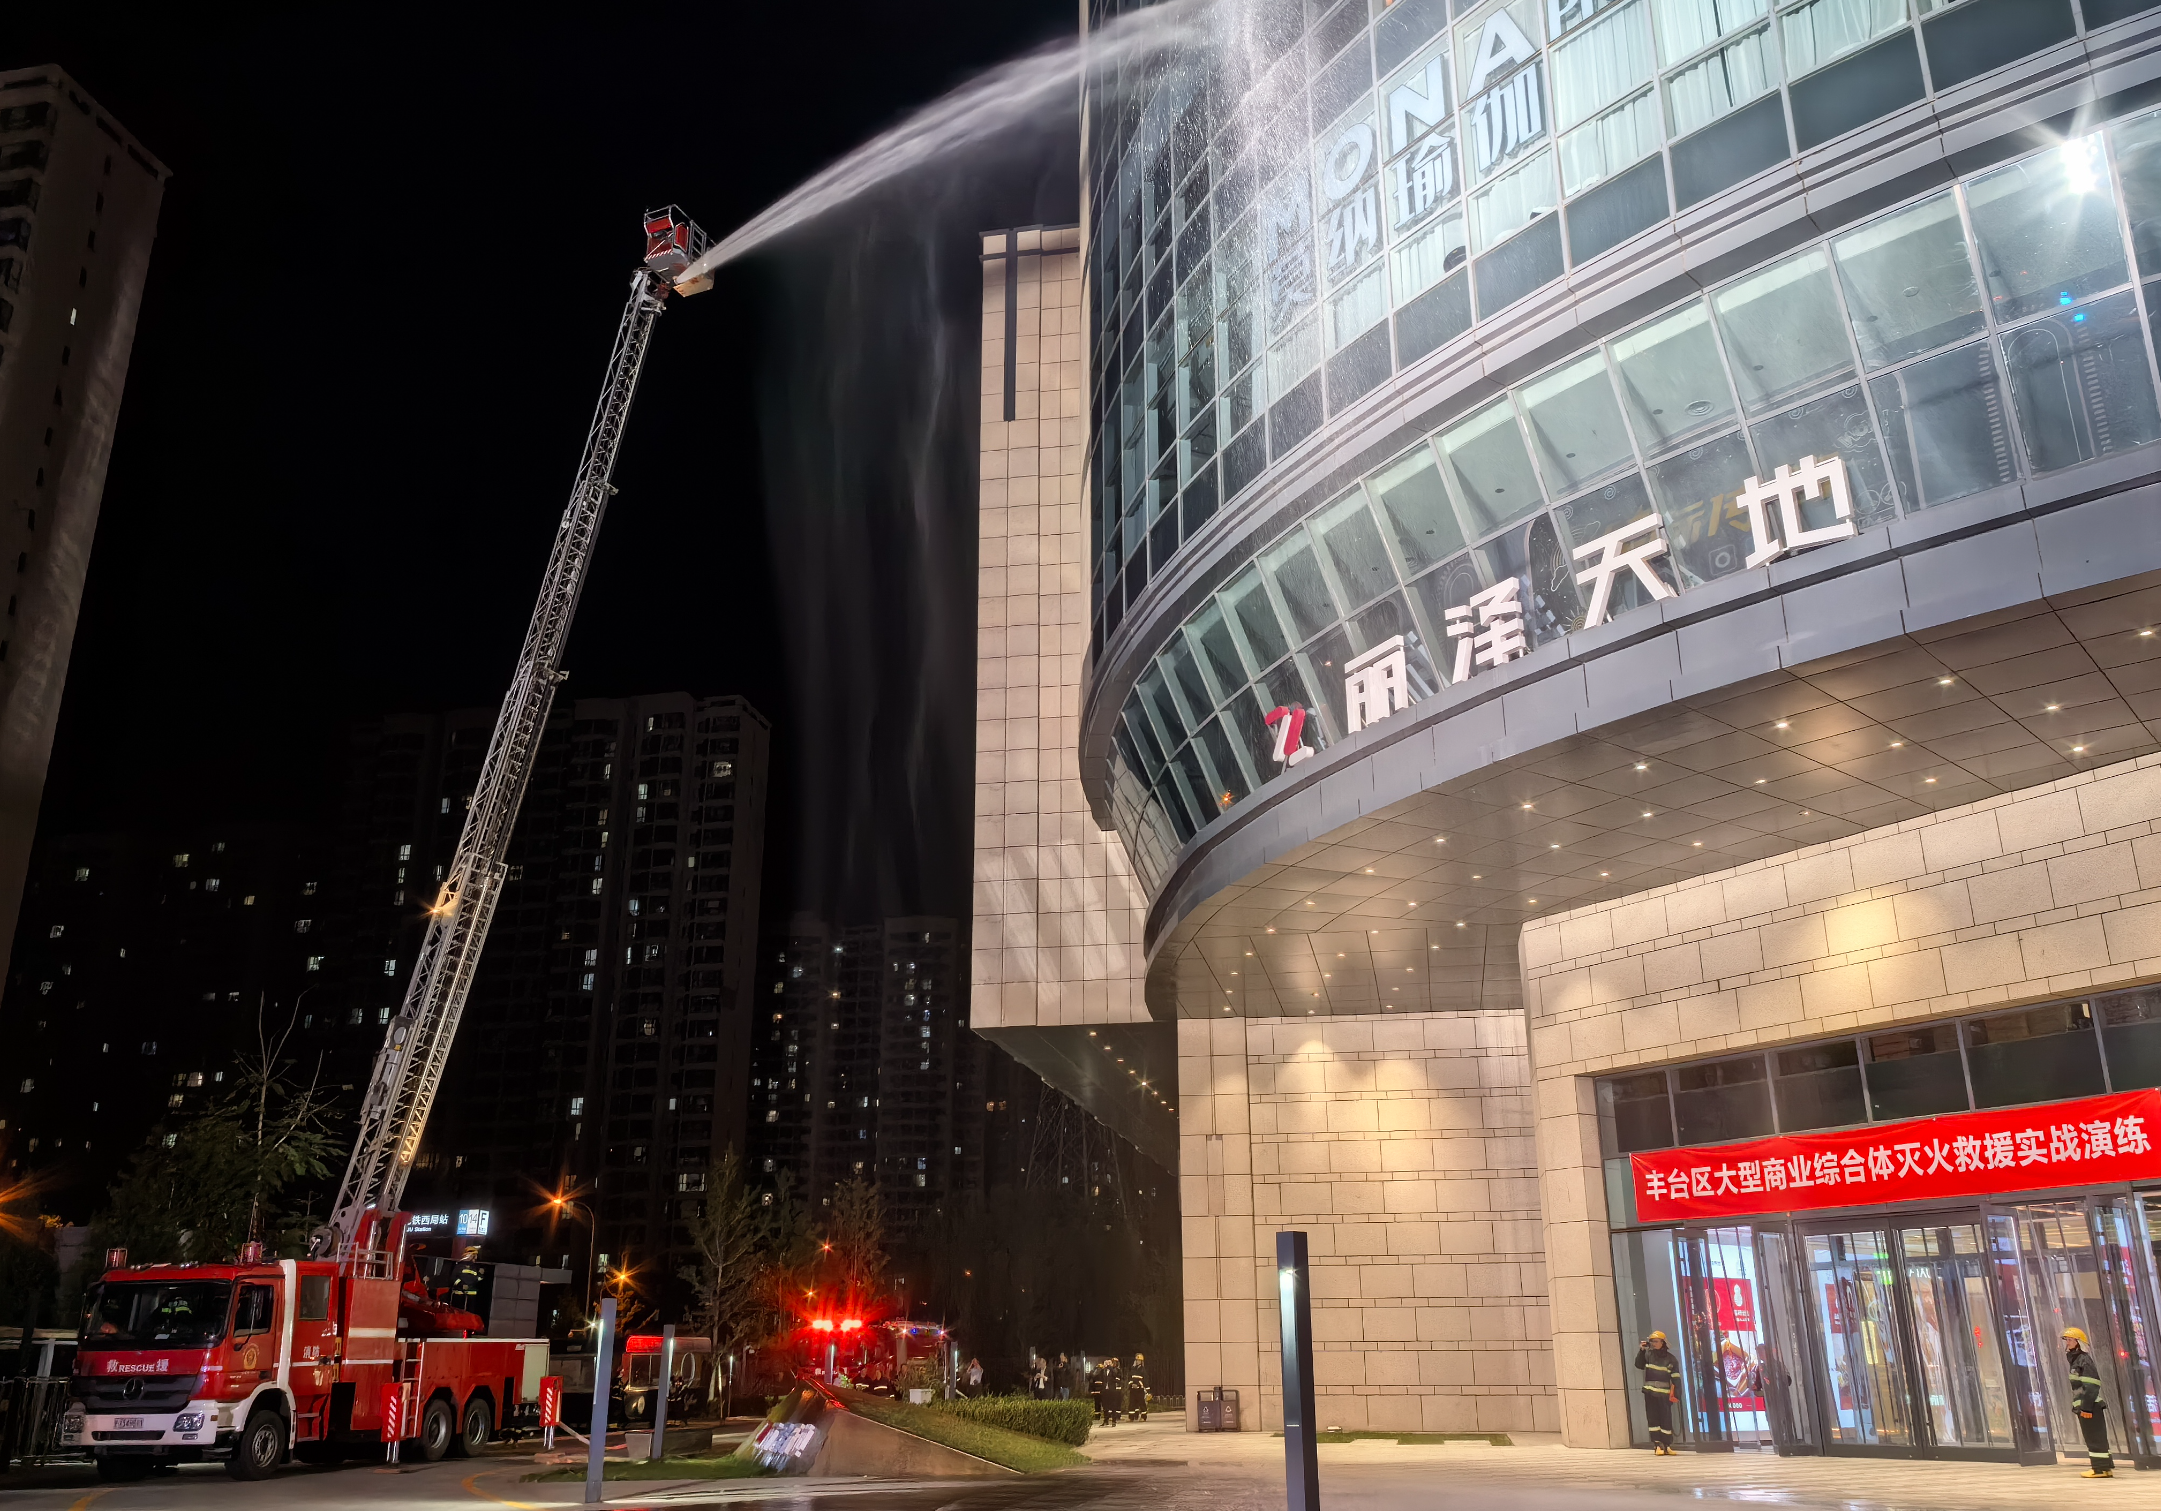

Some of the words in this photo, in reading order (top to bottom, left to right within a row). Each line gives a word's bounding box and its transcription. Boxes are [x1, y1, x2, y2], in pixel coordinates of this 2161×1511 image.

[1343, 455, 1857, 734] 丽泽天地
[1645, 1114, 2151, 1201] 丰台区大型商业综合体灭火救援实战演练
[407, 1214, 449, 1225] 铁西局站
[459, 1213, 468, 1224] 10
[480, 1212, 487, 1226] F
[118, 1364, 155, 1373] RESCUE
